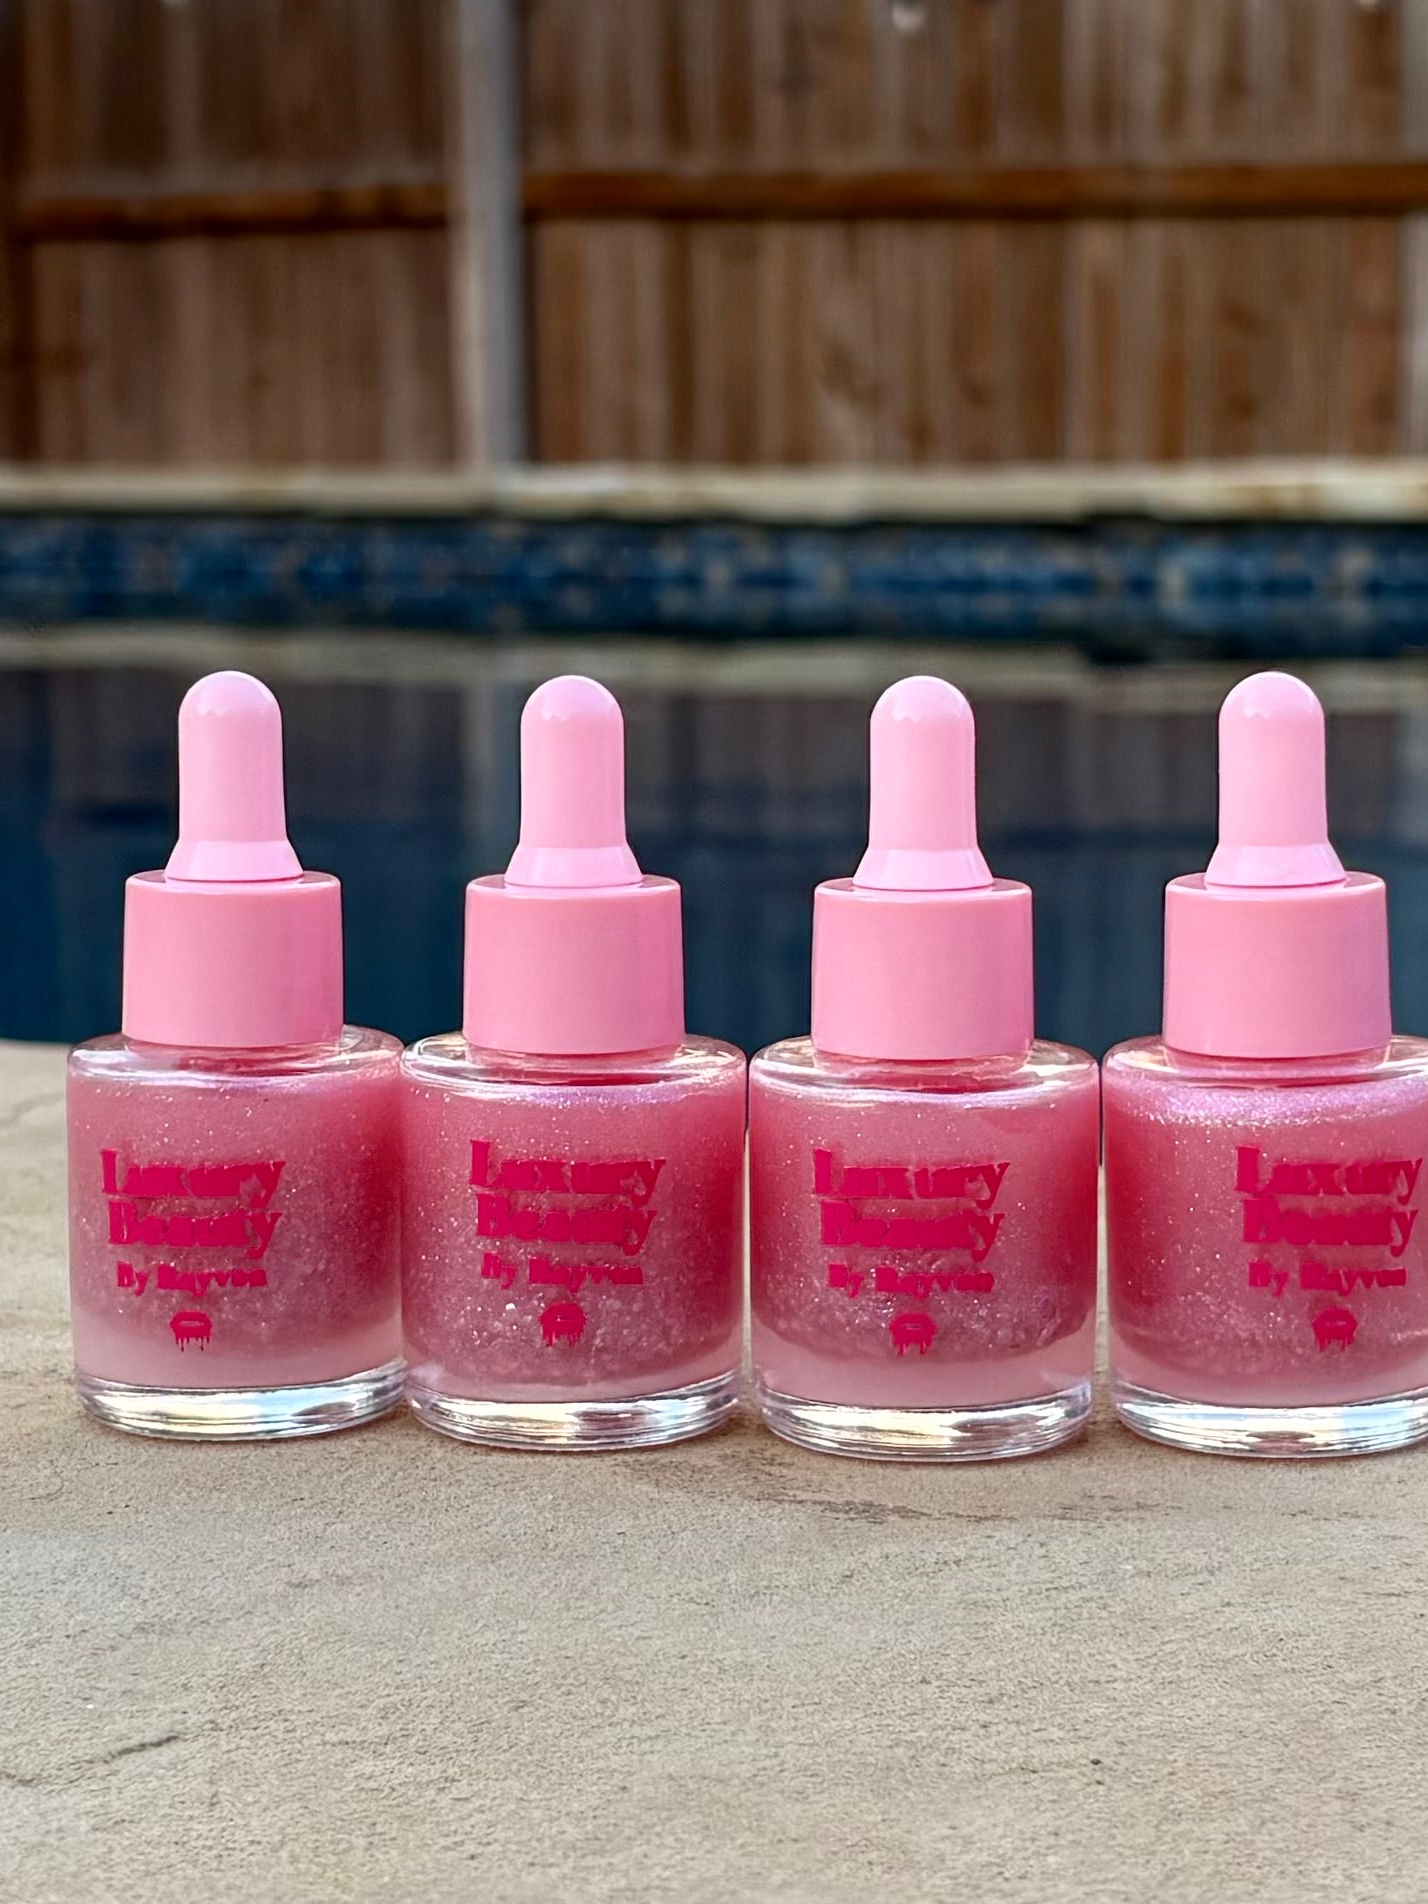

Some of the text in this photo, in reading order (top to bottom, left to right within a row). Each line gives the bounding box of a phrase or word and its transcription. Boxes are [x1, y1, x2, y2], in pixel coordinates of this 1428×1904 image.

[469, 1139, 667, 1208] Luxury
[813, 1148, 1011, 1211] Luxury
[1234, 1146, 1423, 1206] Luxury
[117, 1262, 149, 1297] By
[828, 1263, 865, 1299] By
[1248, 1261, 1289, 1297] By
